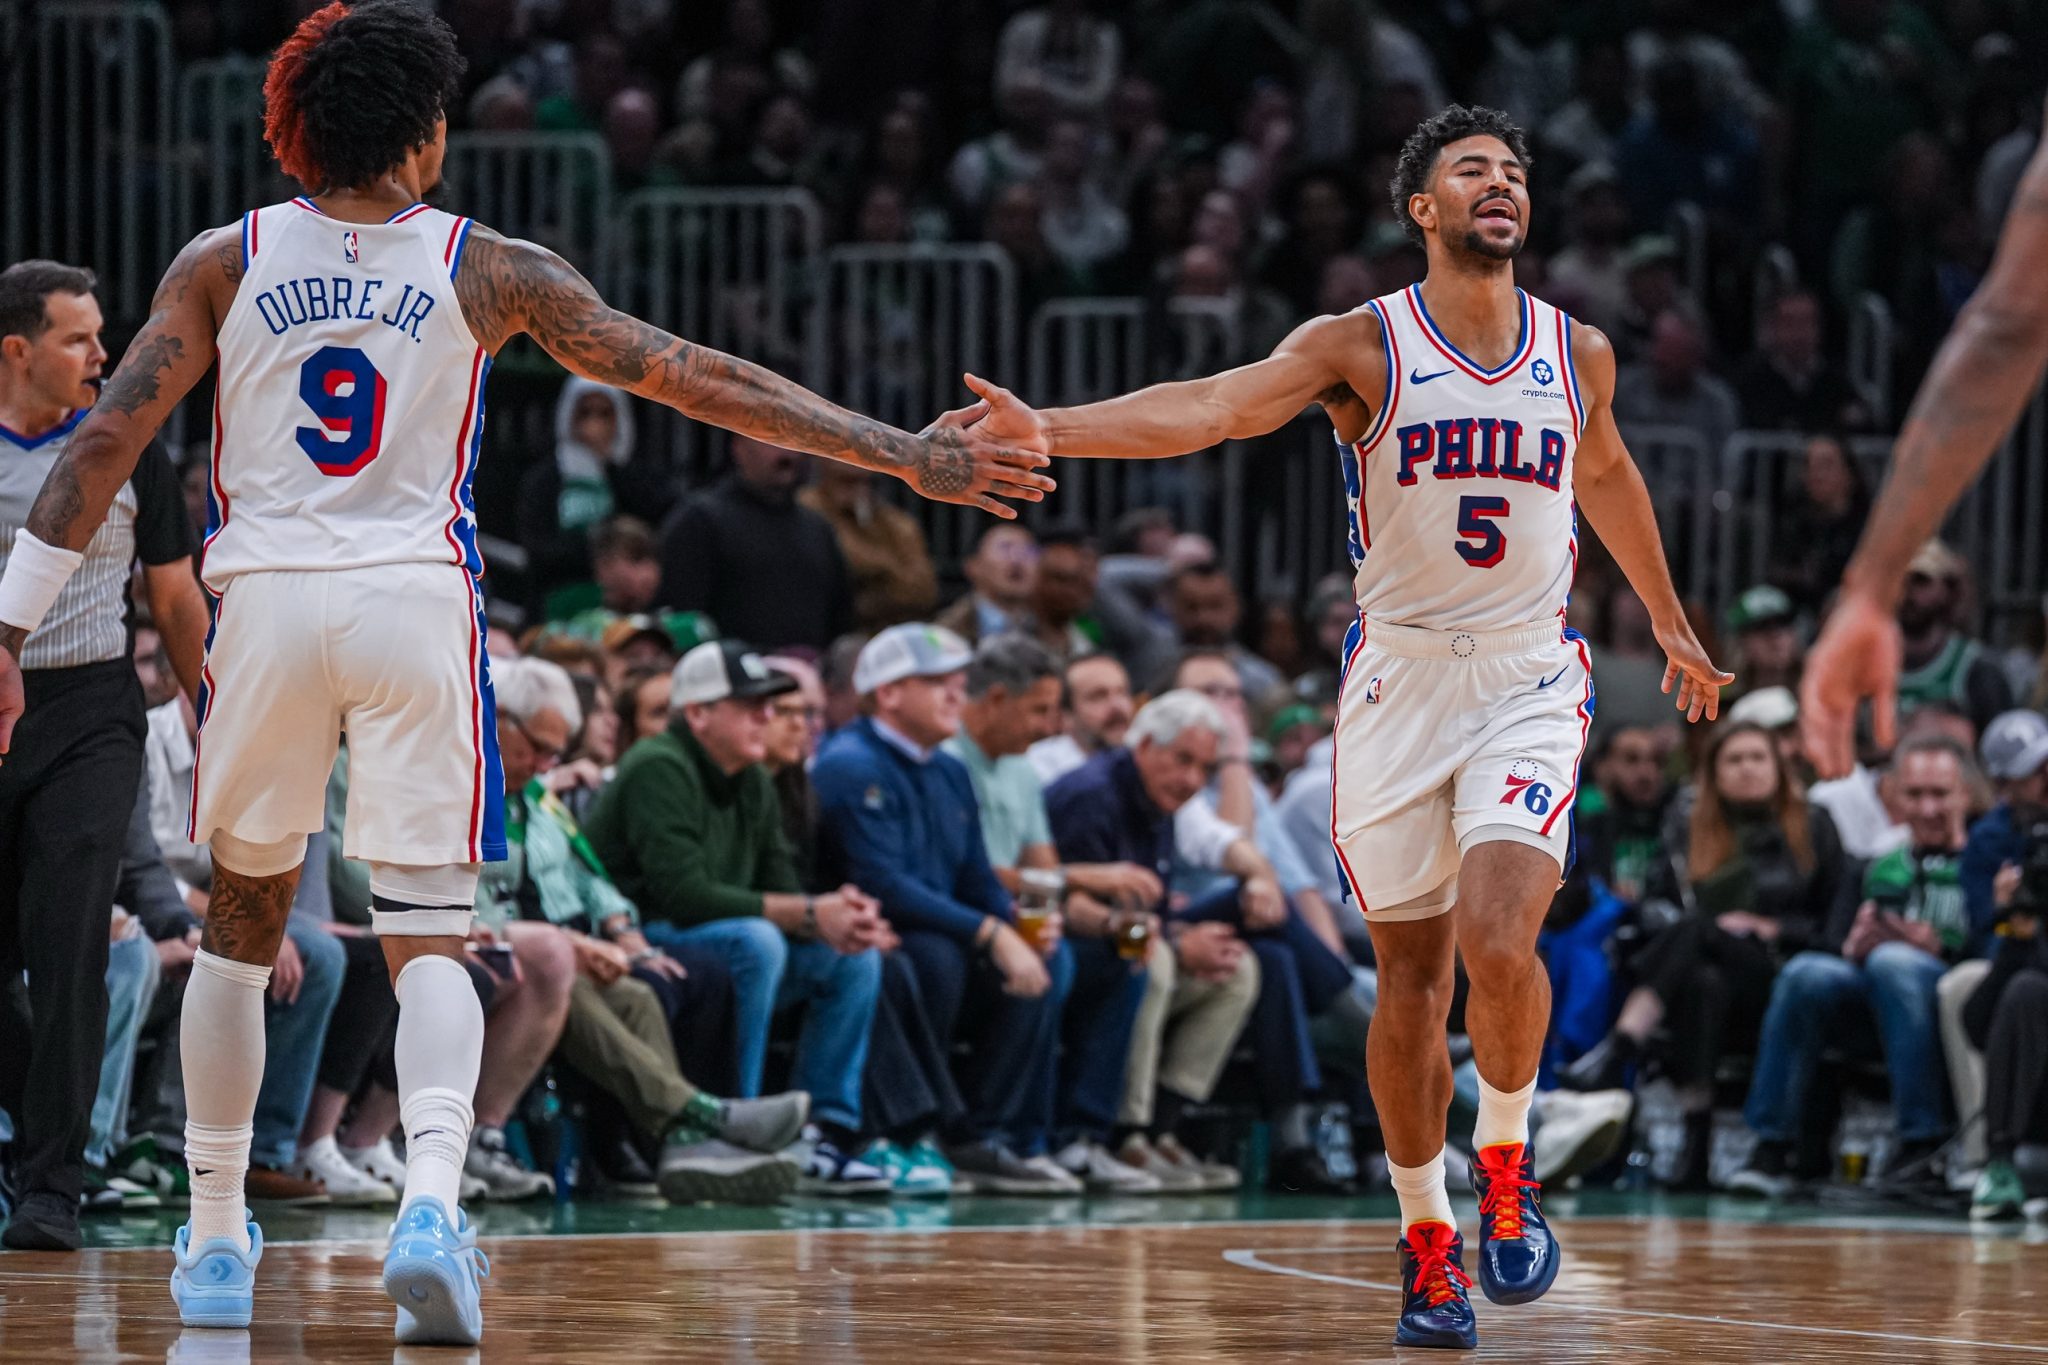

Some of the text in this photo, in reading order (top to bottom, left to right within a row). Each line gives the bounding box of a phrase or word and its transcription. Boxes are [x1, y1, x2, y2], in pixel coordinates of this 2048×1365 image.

[255, 277, 435, 343] OUBRE JR.
[296, 346, 387, 477] 9
[1521, 389, 1566, 400] crypto.com
[1396, 417, 1566, 492] PHILA
[1454, 495, 1510, 568] 5
[1499, 773, 1552, 815] 76
